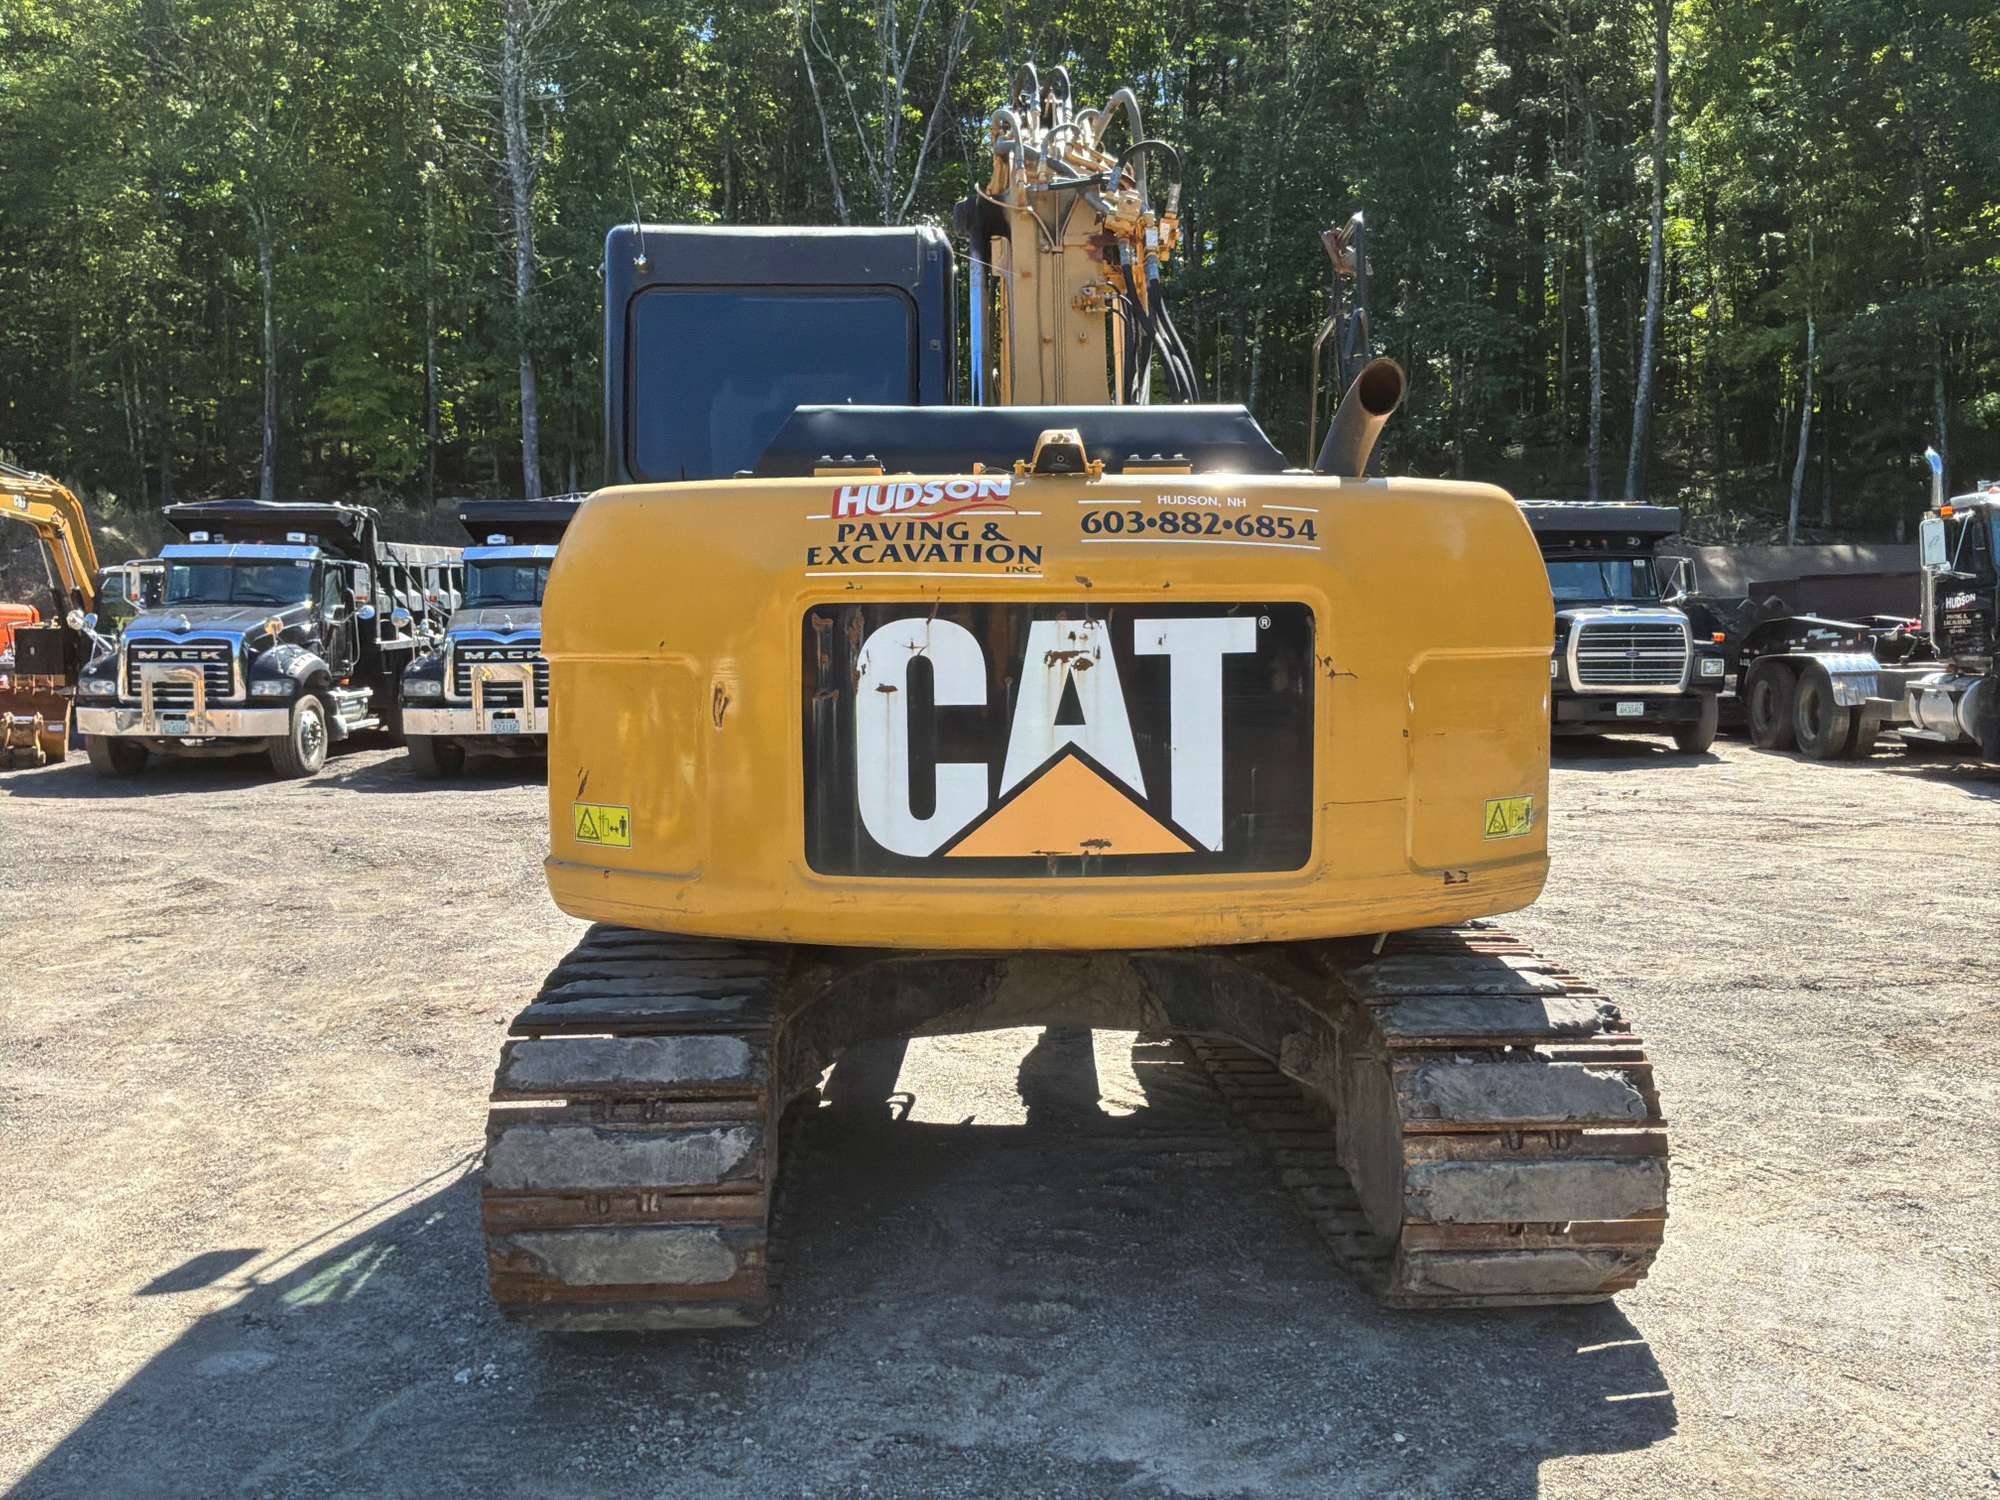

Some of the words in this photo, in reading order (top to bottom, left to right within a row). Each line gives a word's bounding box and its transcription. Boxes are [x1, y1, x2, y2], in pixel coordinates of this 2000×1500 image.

[832, 479, 1012, 519] HUDSON
[1157, 495, 1222, 507] HUDSON,
[1227, 496, 1247, 508] NH
[837, 522, 970, 543] PAVING
[981, 522, 1012, 542] &
[806, 543, 1043, 567] EXCAVATION
[1945, 592, 1977, 609] HUDSON
[137, 650, 221, 660] MACK
[856, 617, 1257, 858] CAT
